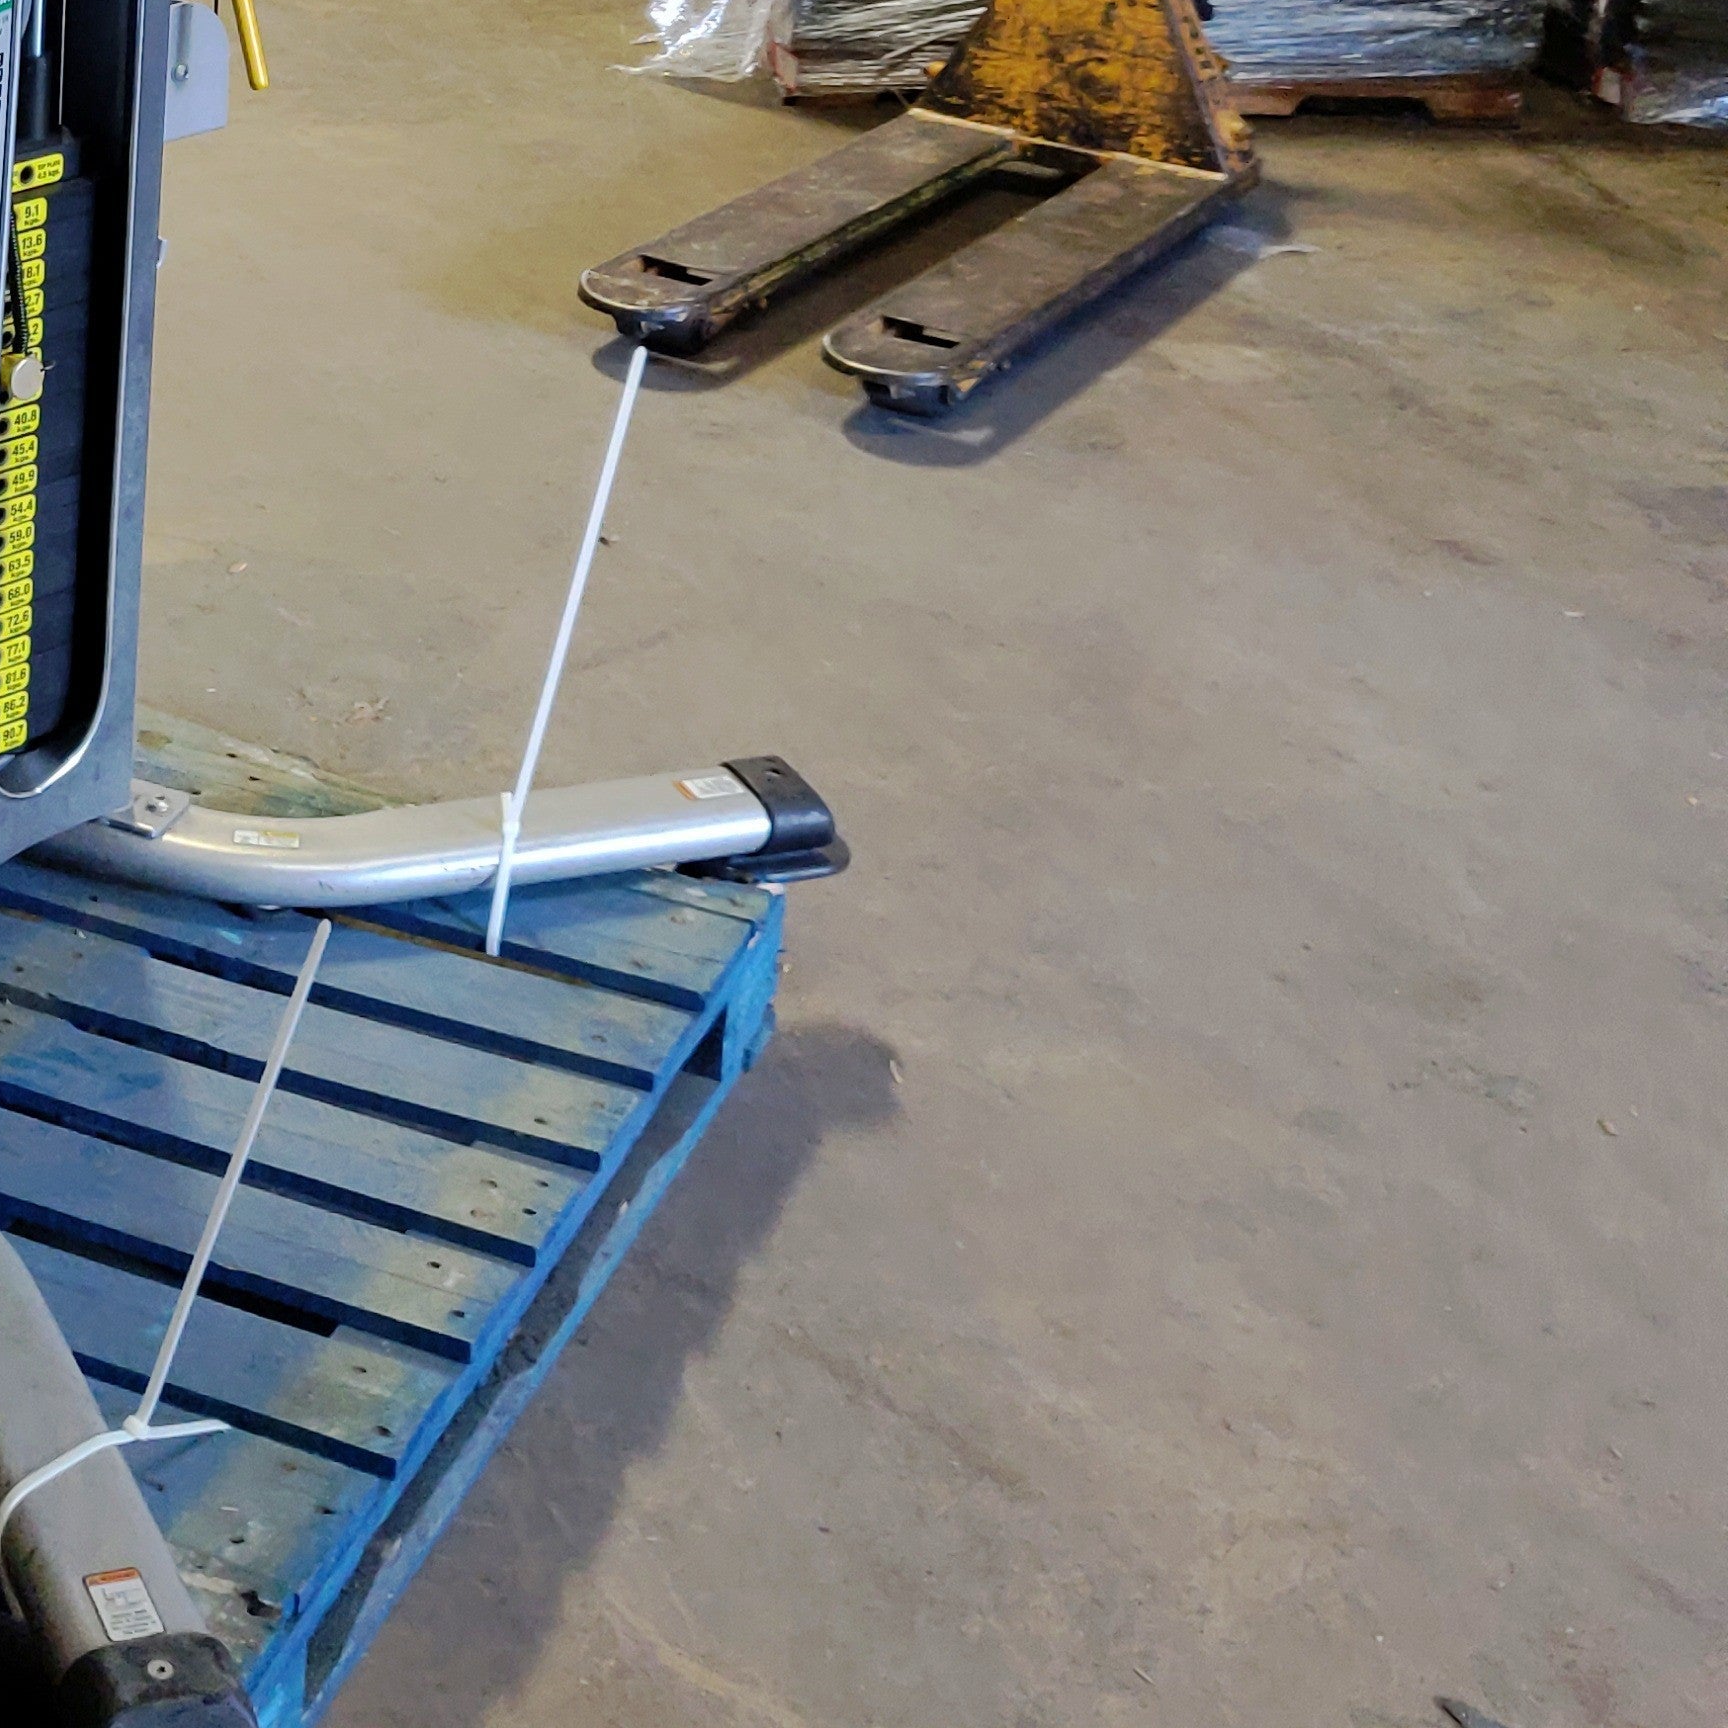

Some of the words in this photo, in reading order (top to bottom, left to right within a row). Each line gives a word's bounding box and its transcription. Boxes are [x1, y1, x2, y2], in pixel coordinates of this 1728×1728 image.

[25, 204, 39, 218] 9.1
[22, 234, 42, 249] 13.6
[14, 410, 37, 425] 40.8
[13, 440, 34, 455] 45.4
[12, 470, 34, 485] 49.9
[11, 498, 33, 516] 54.4
[9, 527, 32, 543] 59.0
[9, 555, 30, 572] 63.5
[8, 583, 30, 600] 68.0
[7, 610, 29, 627] 72.6
[7, 640, 26, 657] 77.1
[3, 725, 24, 741] 90.7
